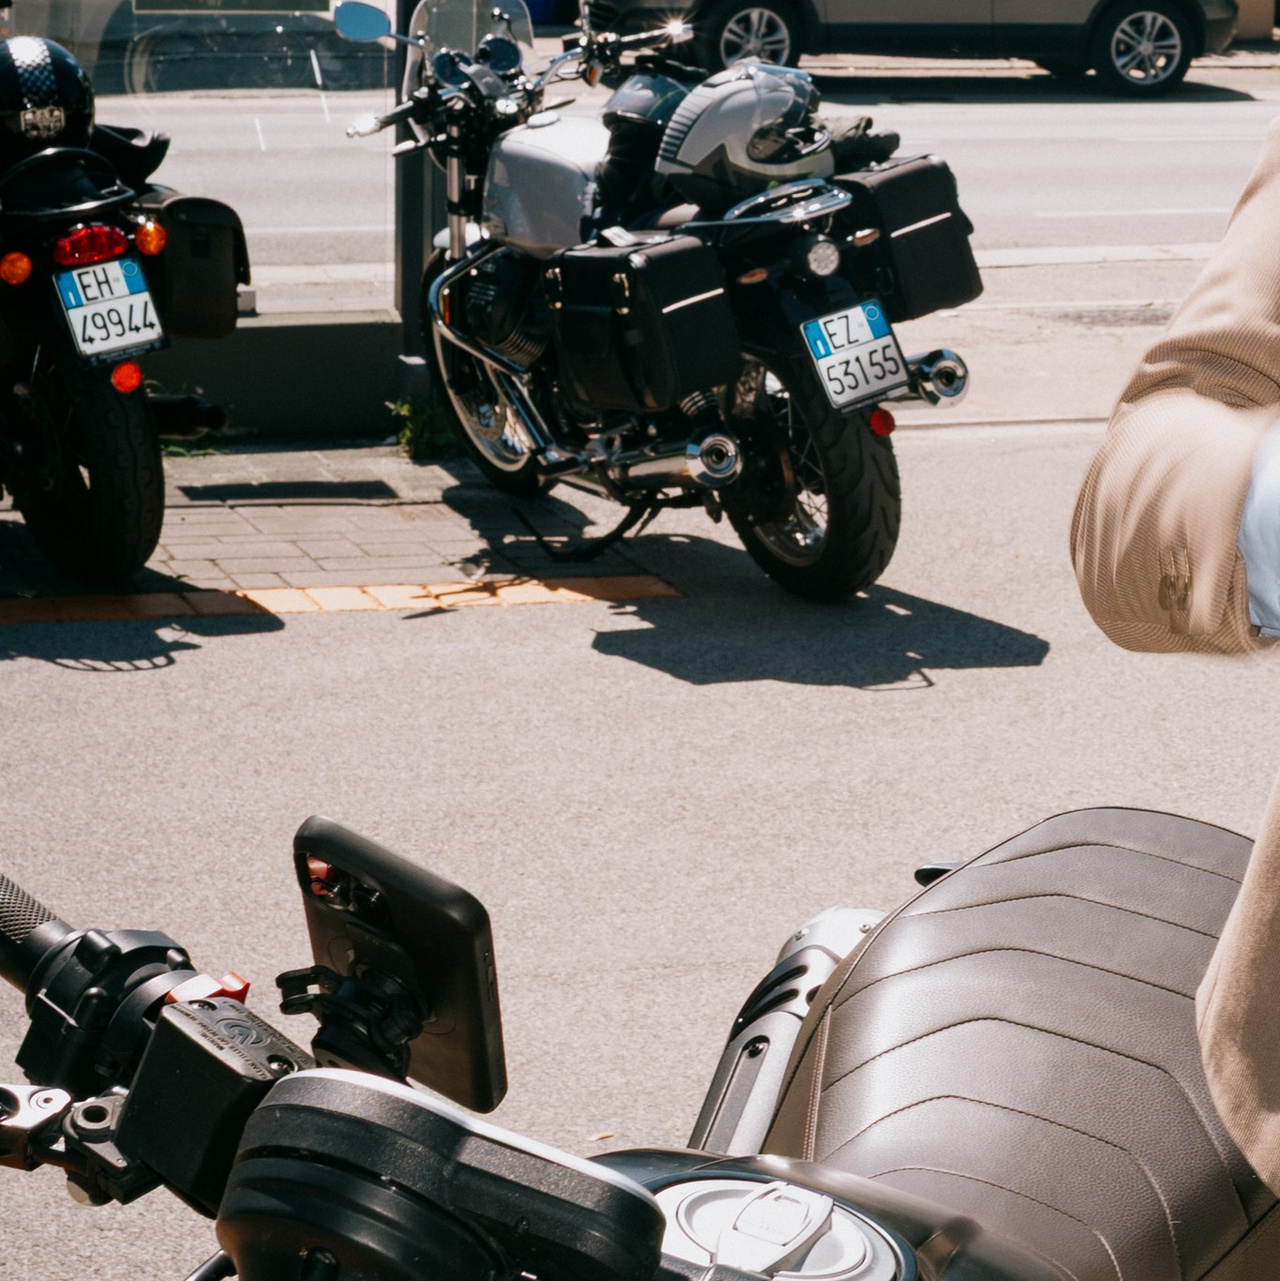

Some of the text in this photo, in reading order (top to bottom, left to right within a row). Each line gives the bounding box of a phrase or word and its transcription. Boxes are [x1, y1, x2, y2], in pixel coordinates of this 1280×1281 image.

[77, 267, 114, 301] EH
[82, 300, 156, 344] 49944
[823, 314, 859, 350] EZ
[826, 344, 900, 395] 53155
